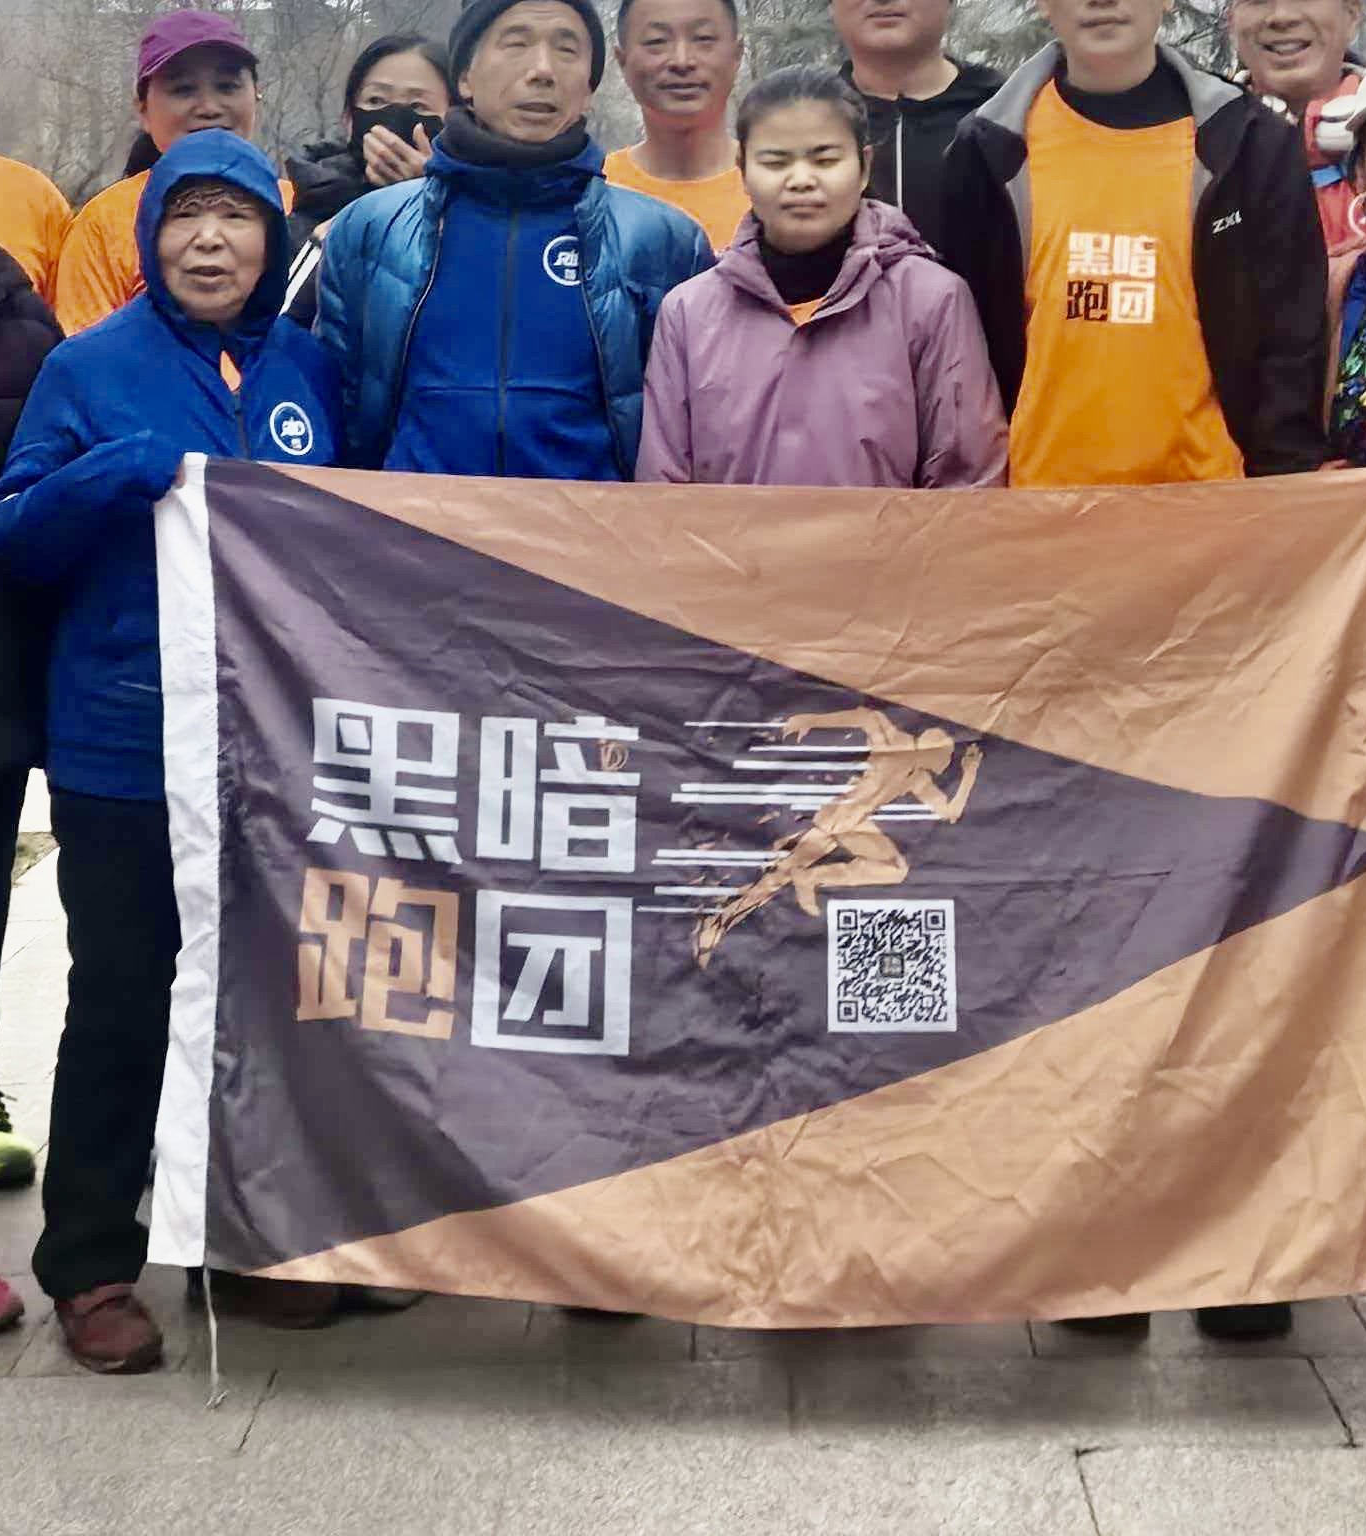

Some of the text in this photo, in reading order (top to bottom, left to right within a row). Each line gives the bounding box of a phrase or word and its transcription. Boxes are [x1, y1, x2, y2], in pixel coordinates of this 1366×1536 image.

[1066, 279, 1155, 323] 跑团
[1067, 231, 1157, 277] 黑暗
[307, 697, 641, 872] 黑暗
[297, 866, 634, 1056] 跑团
